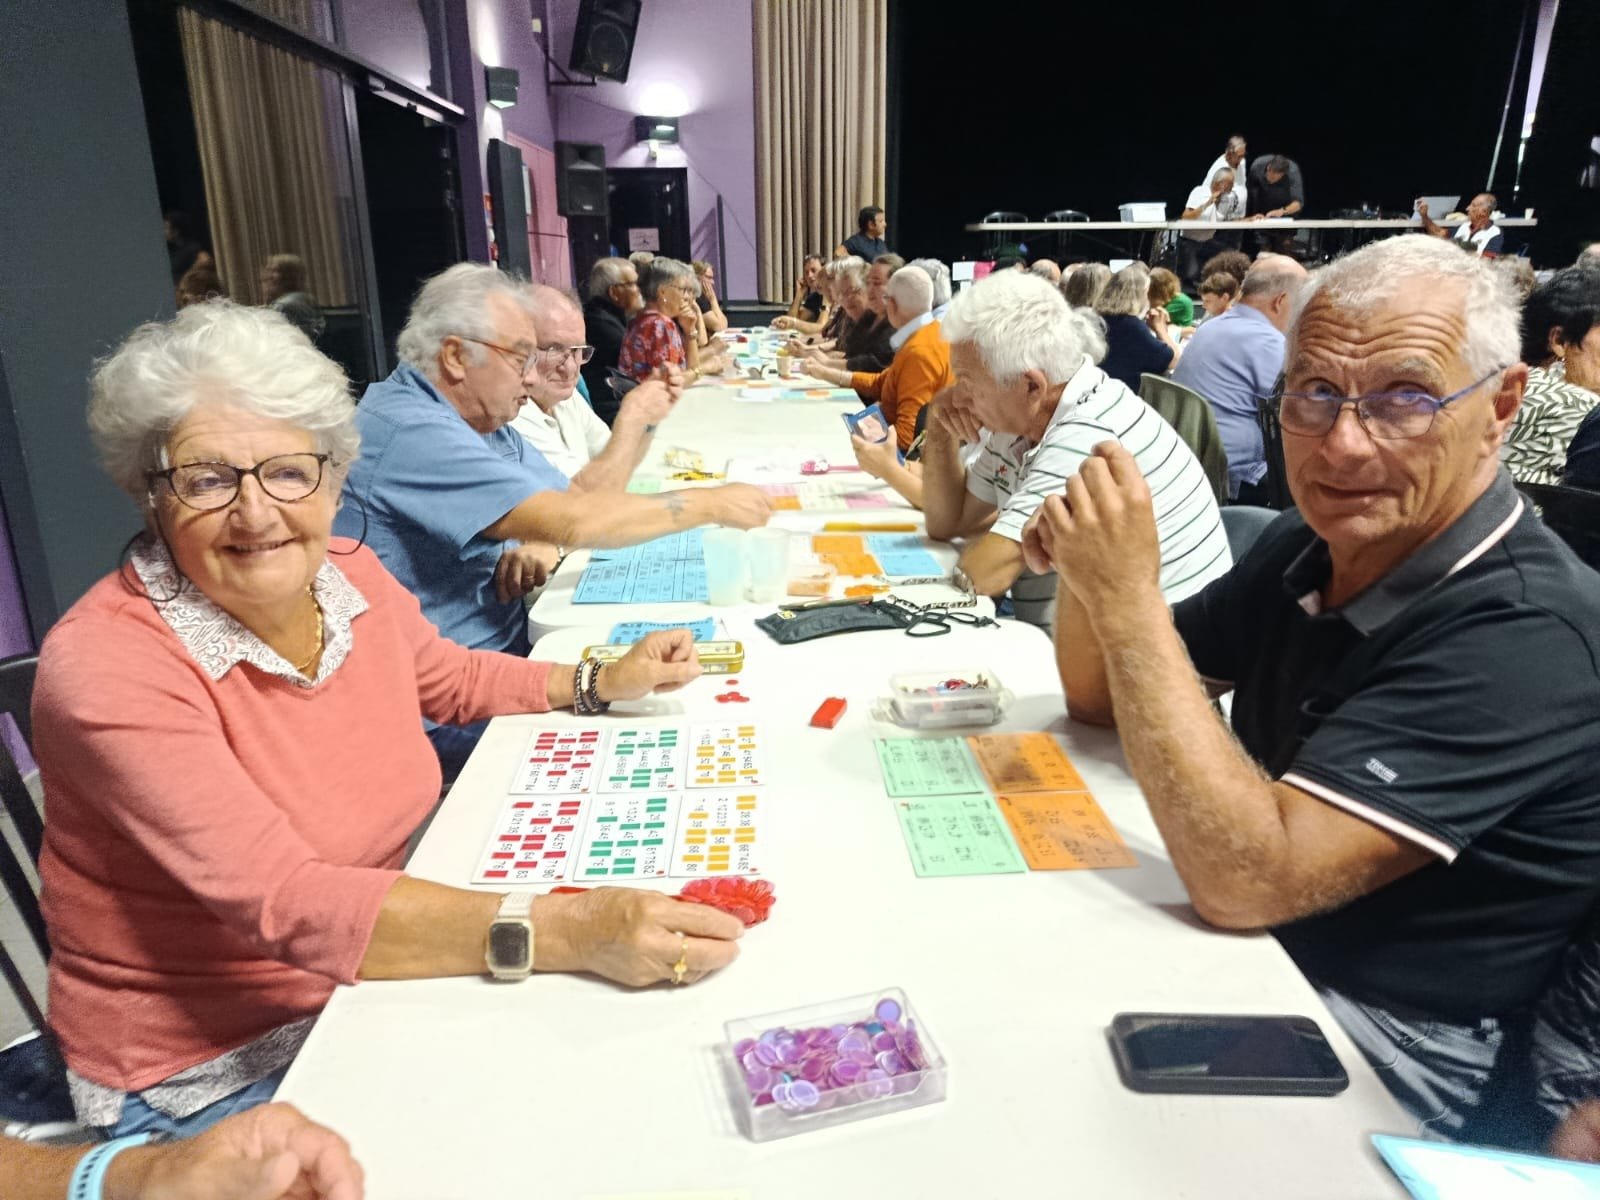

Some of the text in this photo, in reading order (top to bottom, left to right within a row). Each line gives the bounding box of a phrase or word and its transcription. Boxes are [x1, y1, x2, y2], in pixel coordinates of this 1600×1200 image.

[553, 833, 566, 841] 42
[644, 855, 655, 864] 75
[541, 869, 555, 878] 90
